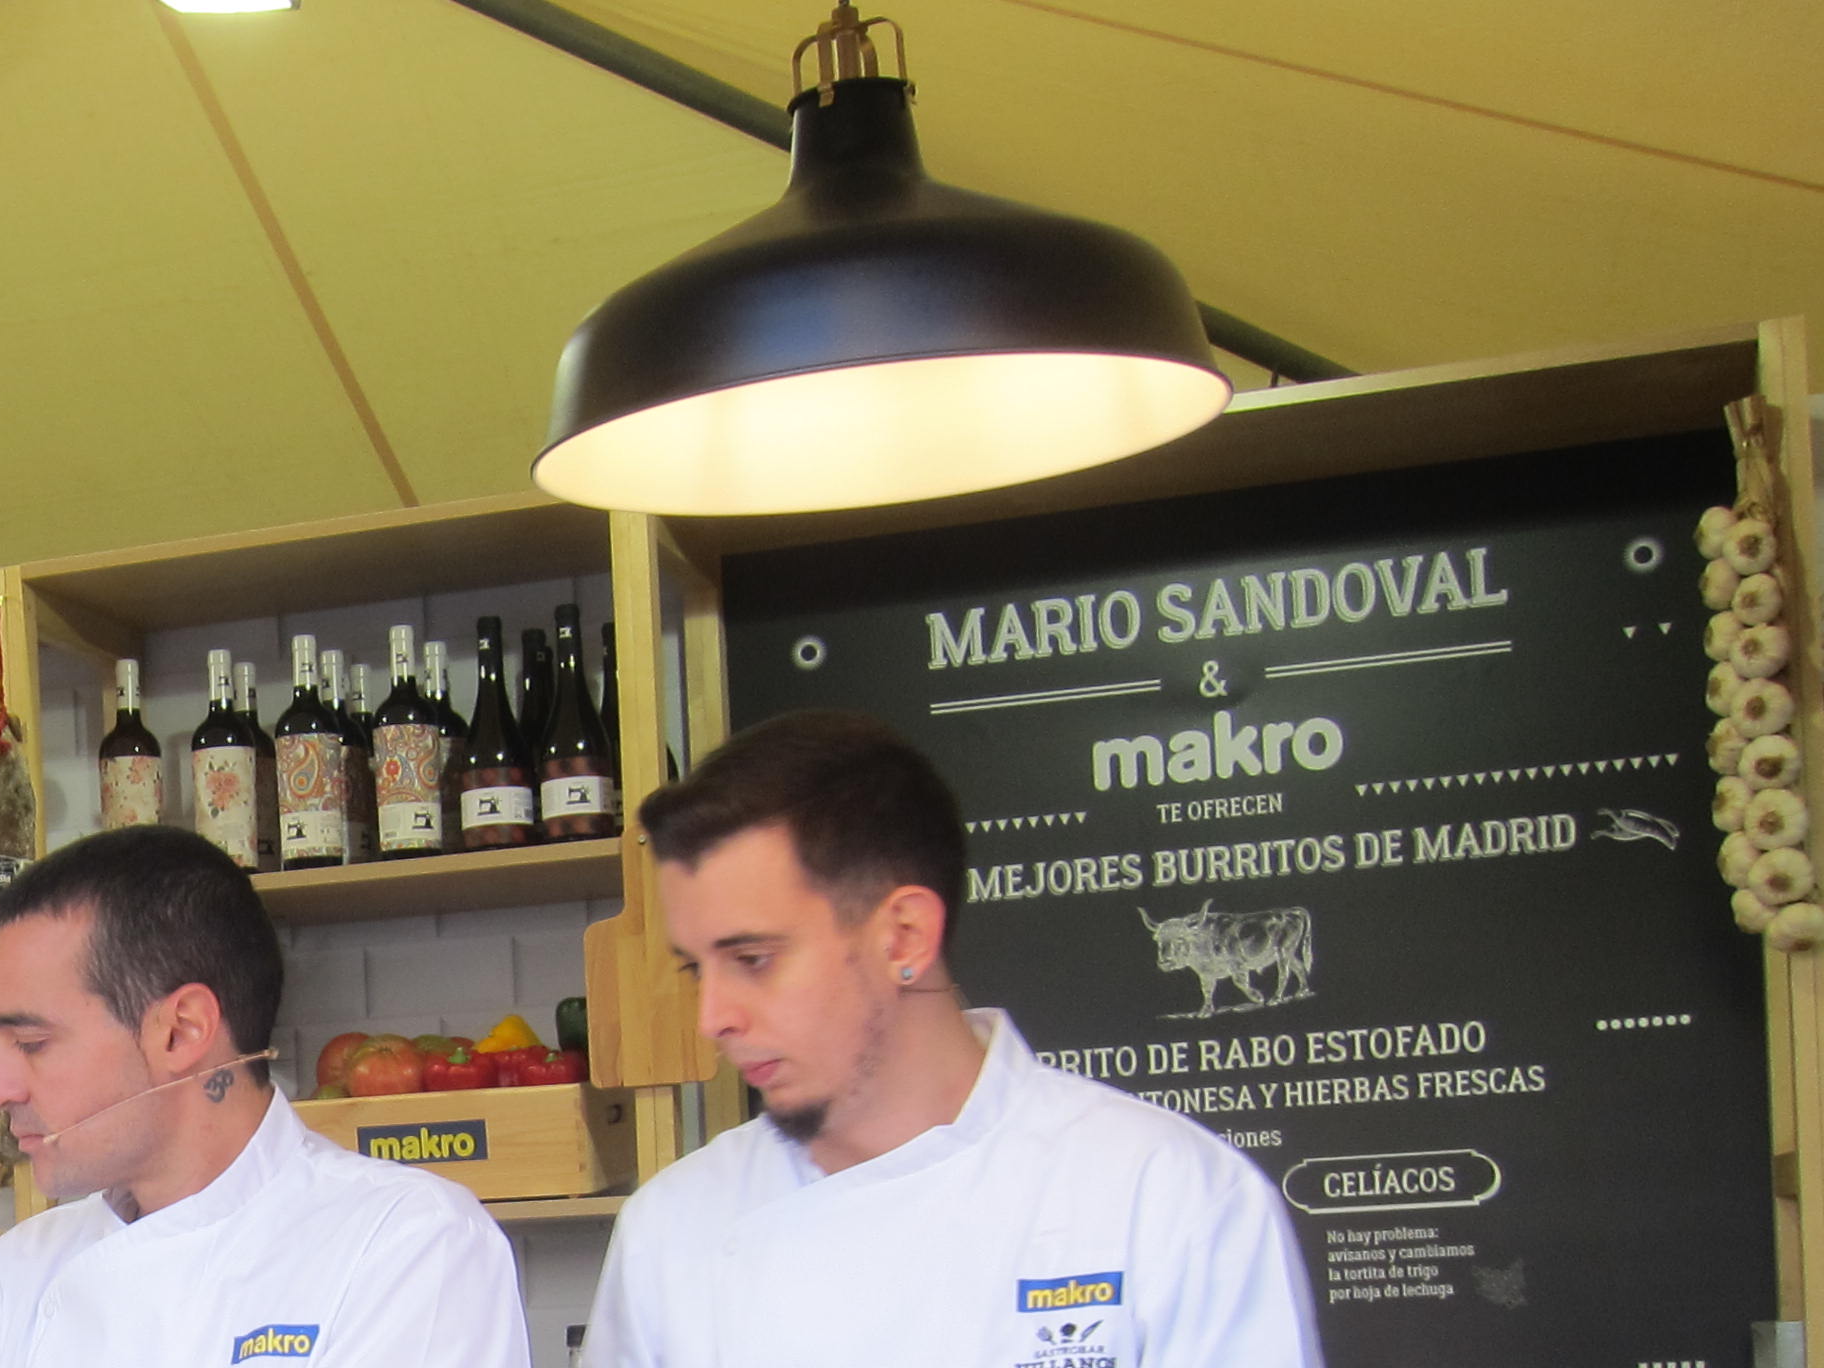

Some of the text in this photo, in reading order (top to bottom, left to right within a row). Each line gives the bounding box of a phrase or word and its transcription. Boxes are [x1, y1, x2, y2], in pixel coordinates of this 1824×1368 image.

[925, 547, 1509, 670] MARIO SANDOVAL
[1198, 659, 1229, 698] &
[1092, 709, 1344, 792] makro
[1156, 793, 1284, 825] TE OFRECEN
[966, 812, 1578, 903] MEJORES BURRITOS DE MADRID
[1147, 1041, 1190, 1075] DE
[1199, 1033, 1296, 1070] RABO
[1306, 1020, 1487, 1064] ESTOFADO
[1138, 1065, 1546, 1114] TONESA Y HIERBAS FRESCAS
[368, 1126, 476, 1160] makro
[1323, 1163, 1456, 1198] CELÍACOS
[1327, 1226, 1439, 1246] No hay problema:
[1388, 1249, 1398, 1263] y
[1399, 1244, 1475, 1258] cambiamos
[1328, 1264, 1439, 1281] la tortita de trigo
[1026, 1279, 1115, 1309] makro
[1329, 1282, 1455, 1304] por hoja de lechuga
[238, 1327, 311, 1360] makro
